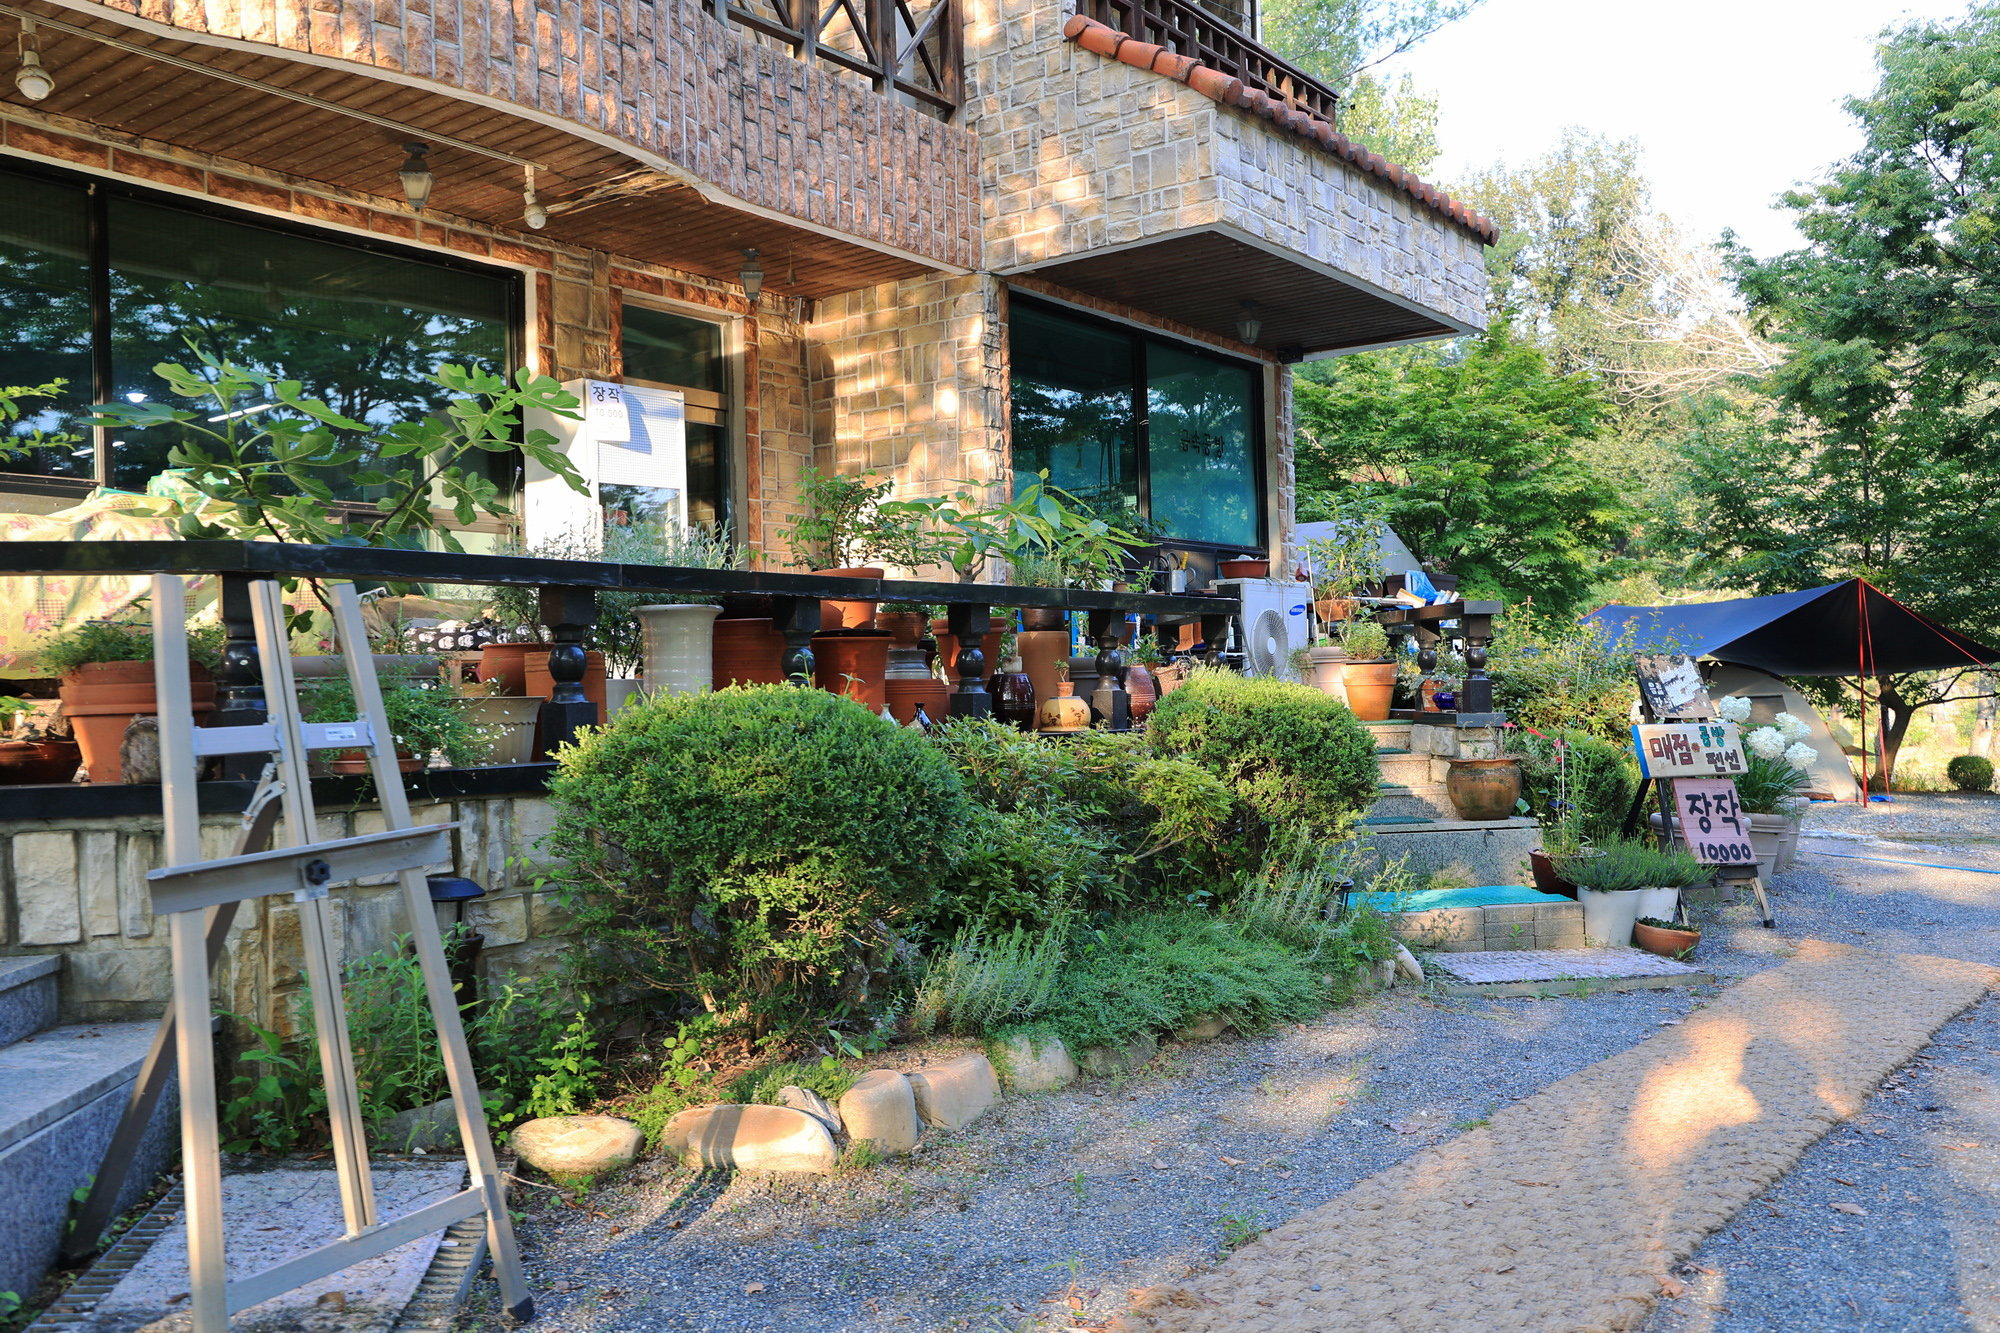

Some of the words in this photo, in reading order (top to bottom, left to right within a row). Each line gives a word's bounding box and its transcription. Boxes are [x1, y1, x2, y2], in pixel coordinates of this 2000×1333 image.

[592, 386, 620, 403] 장작
[1180, 429, 1225, 458] 금속공방
[1649, 733, 1694, 766] 매점
[1698, 726, 1725, 748] 공방
[1685, 789, 1742, 836] 장작
